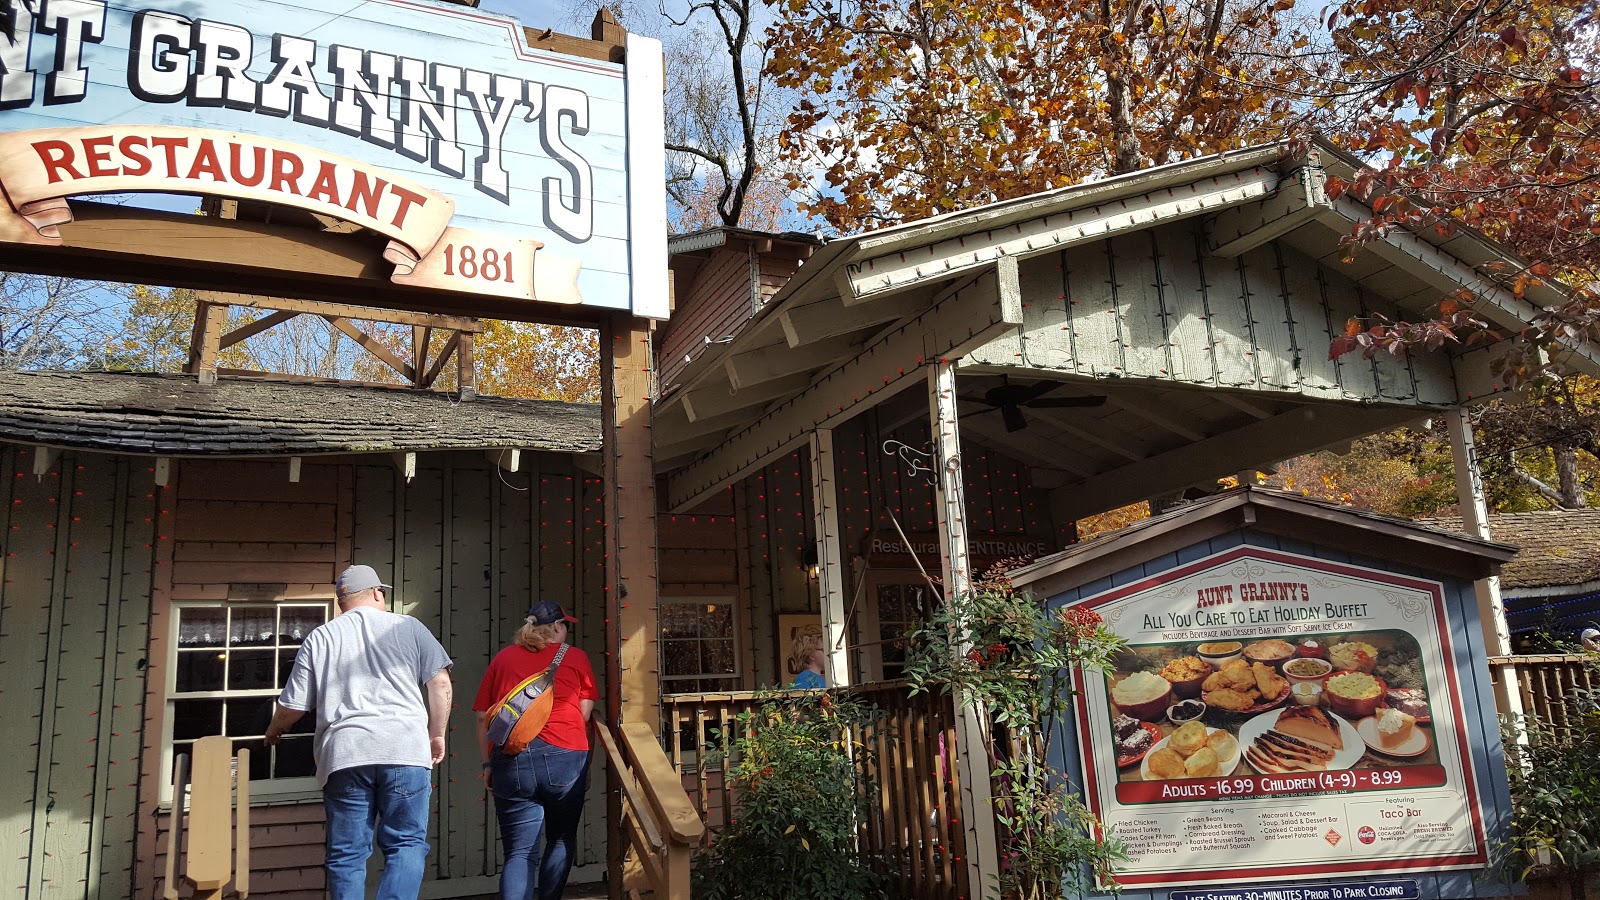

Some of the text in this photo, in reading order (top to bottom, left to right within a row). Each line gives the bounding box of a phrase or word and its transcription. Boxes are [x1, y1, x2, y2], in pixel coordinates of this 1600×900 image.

[126, 8, 593, 244] GRANNY'S
[30, 135, 427, 231] RESTAURANT
[442, 242, 515, 283] 1881
[872, 538, 1046, 556] Restaura ENTRANCE
[1197, 582, 1310, 608] AUNT GRANNY'S
[1143, 603, 1368, 629] ALL YOU CARE TO EAT HOLIDAY BUFFET
[1162, 632, 1189, 640] INCLUDES
[1189, 630, 1219, 639] BEVERAGE
[1232, 628, 1257, 636] DESSERT
[1258, 627, 1272, 635] BAR
[1287, 625, 1302, 633] SOFT
[1303, 624, 1321, 632] SERVE
[1322, 623, 1332, 631] ICE
[1332, 622, 1353, 630] CREAM
[1162, 784, 1207, 797] ADULTS
[1260, 778, 1316, 792] CHILDREN
[1371, 770, 1402, 785] 8.99
[1385, 796, 1415, 804] Featuring
[1380, 808, 1421, 819] Taco Bar
[1281, 818, 1299, 826] Salad
[1305, 816, 1328, 824] Dessert
[1188, 830, 1220, 838] Cornbread
[1263, 825, 1318, 834] Cooked Cabbage
[1264, 833, 1276, 841] and
[1294, 831, 1318, 839] Potatoes
[1120, 834, 1139, 842] Cades
[1152, 840, 1183, 848] Dumplings
[1189, 837, 1213, 845] Roasted
[1304, 889, 1330, 900] PRIOR
[1331, 887, 1342, 899] TO
[1344, 887, 1367, 898] PARK
[1368, 885, 1404, 897] CLOSING
